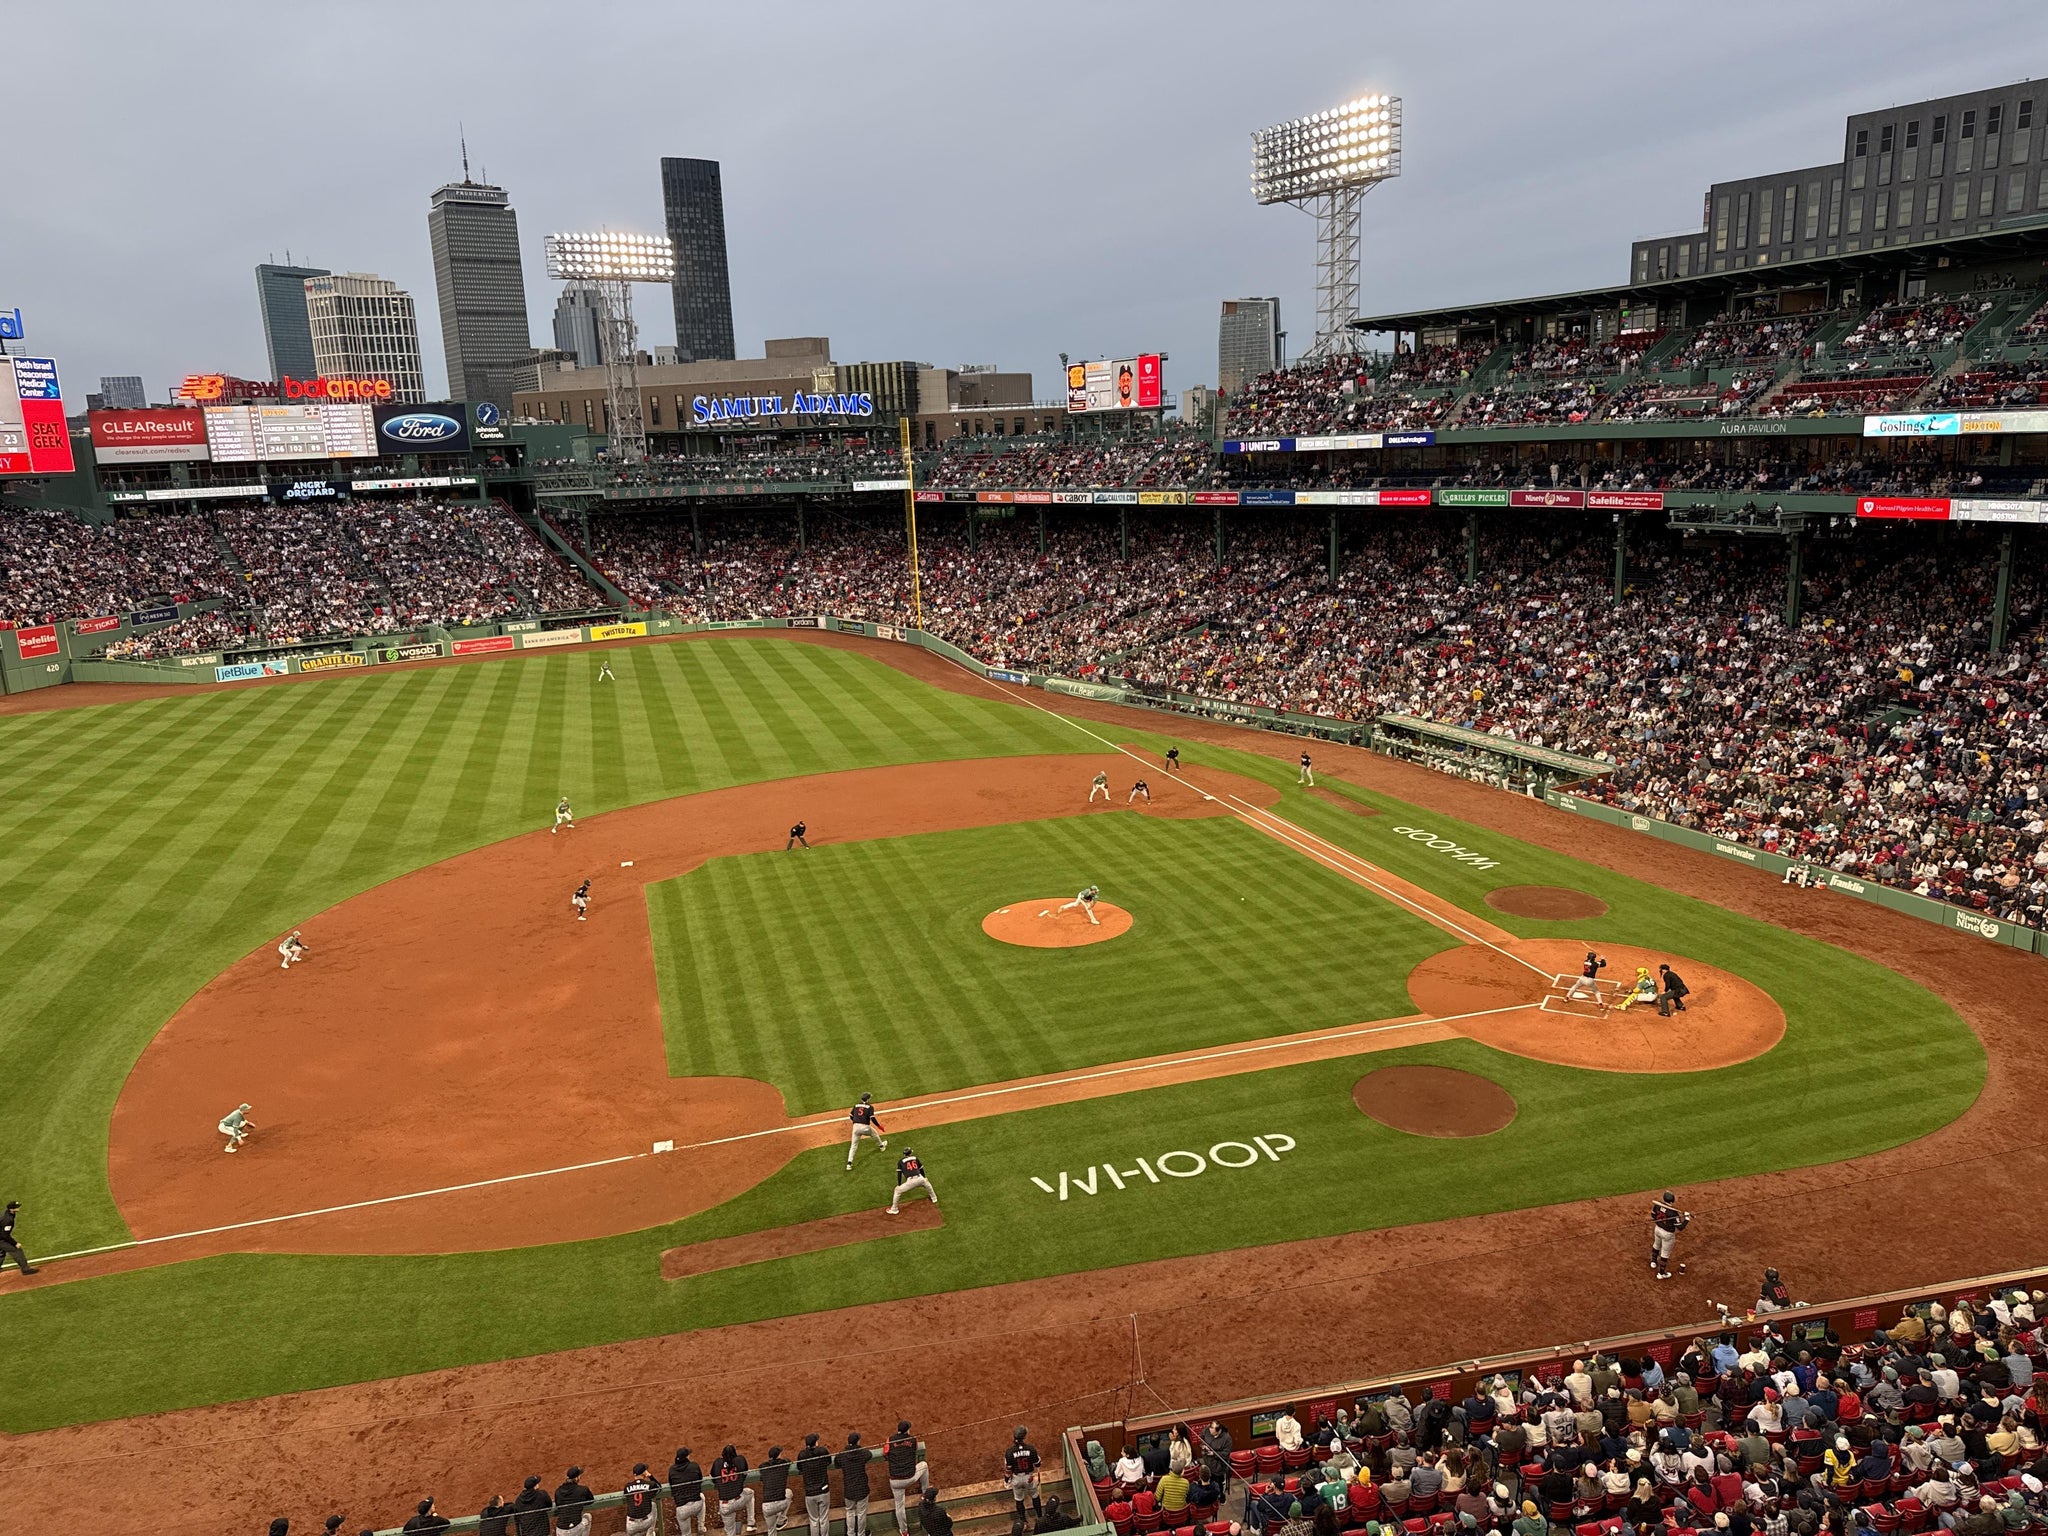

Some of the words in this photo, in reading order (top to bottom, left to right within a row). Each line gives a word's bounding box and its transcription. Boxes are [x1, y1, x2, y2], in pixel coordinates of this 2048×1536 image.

[15, 360, 33, 370] Beth
[33, 362, 52, 370] Israel
[17, 370, 55, 379] Deaconess
[19, 379, 46, 388] Medical
[232, 379, 281, 398] new
[284, 375, 391, 398] balance
[20, 388, 45, 397] Center
[692, 395, 789, 424] SAMUEL
[790, 391, 873, 417] ADAMS
[32, 422, 60, 435] SEAT
[102, 420, 194, 434] CLEAResult
[398, 418, 445, 438] Ford
[1748, 423, 1787, 433] PAVILION
[1879, 420, 1926, 434] Goslings
[1963, 421, 2001, 431] BUXTON
[33, 435, 64, 449] GEEK
[1249, 441, 1280, 451] UNITED
[293, 481, 327, 490] ANGRY
[286, 487, 335, 498] ORCHARD
[1450, 494, 1476, 502] GRILLO'S
[1478, 494, 1506, 502] PICKLES
[1525, 494, 1545, 503] Ninety
[1556, 495, 1570, 503] Nine
[1589, 496, 1624, 505] Safelite
[1875, 504, 1896, 512] Harvard
[1896, 505, 1914, 513] Pilgrim
[1992, 512, 2018, 520] BOSTON
[94, 618, 118, 631] TICKET
[657, 620, 670, 628] 380
[601, 627, 625, 638] TWISTED
[626, 627, 637, 635] TEA
[19, 634, 56, 647] Safelite
[399, 645, 437, 657] wasabi
[182, 656, 204, 667] DICK'S
[301, 655, 343, 670] GRANITE
[343, 653, 365, 665] CITY
[46, 664, 59, 673] 420
[221, 664, 258, 680] jetBlue
[1068, 684, 1095, 698] L.L.Bean
[1392, 826, 1501, 870] WHOOP
[1716, 842, 1757, 861] smartwater
[1957, 911, 1981, 924] Ninety
[1956, 917, 1980, 932] Nine
[858, 1107, 864, 1116] 5
[906, 1160, 918, 1171] 46
[1030, 1133, 1296, 1200] WHOOP
[626, 1483, 650, 1493] LARNACH
[633, 1493, 642, 1507] 9
[1332, 1494, 1346, 1511] 19
